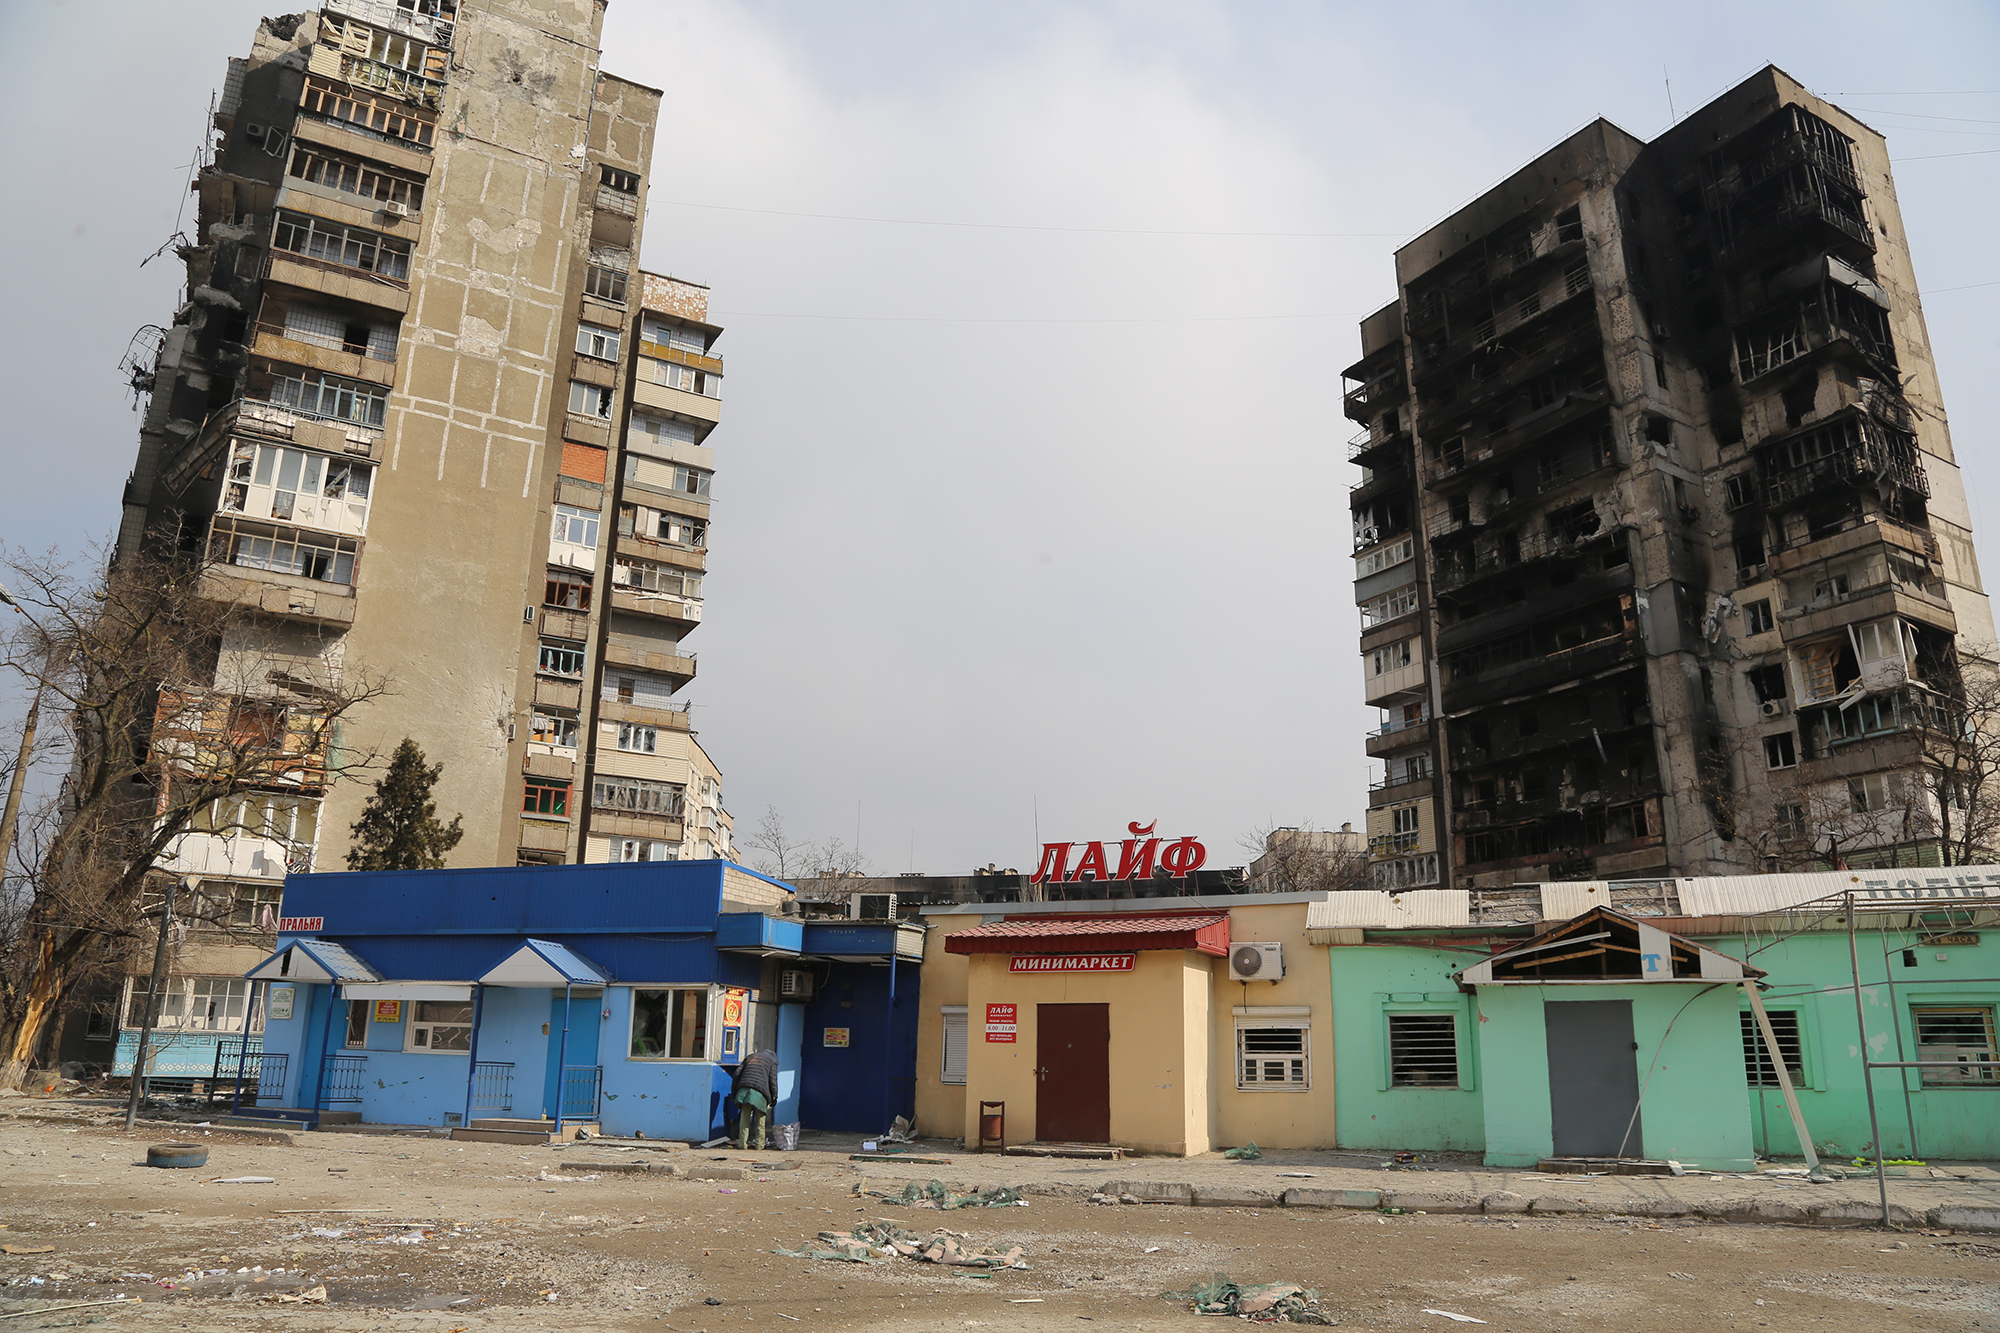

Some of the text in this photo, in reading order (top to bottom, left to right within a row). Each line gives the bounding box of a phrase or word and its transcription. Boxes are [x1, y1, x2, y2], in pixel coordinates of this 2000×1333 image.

[1030, 818, 1207, 885] ЛАЙФ
[279, 918, 322, 931] ПРАЛЬНЯ
[1948, 936, 1973, 944] ЧАСА
[1013, 957, 1131, 970] МИНИМАРКЕТ
[990, 1005, 1014, 1014] ЛАЙФ
